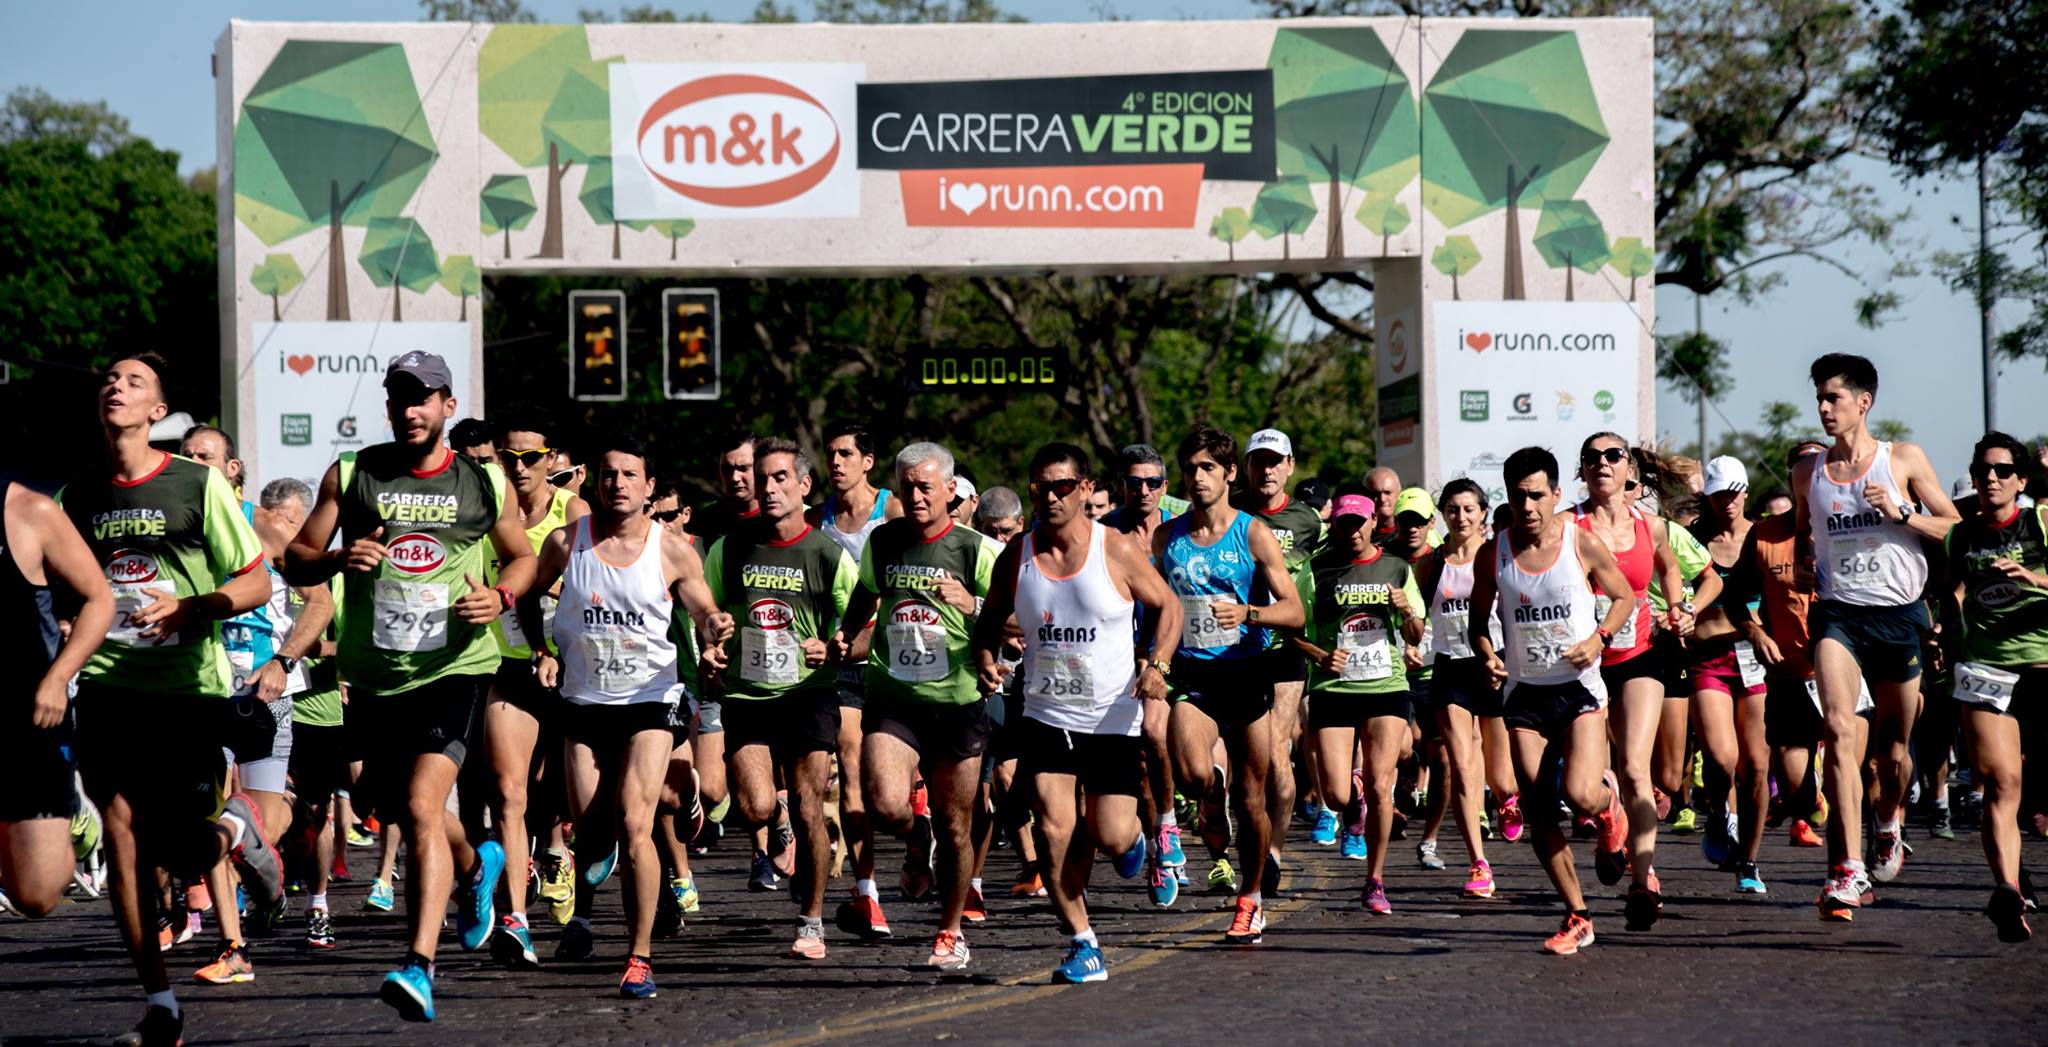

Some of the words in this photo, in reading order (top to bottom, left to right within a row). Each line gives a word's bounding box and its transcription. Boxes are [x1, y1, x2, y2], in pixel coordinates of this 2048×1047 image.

[1152, 91, 1253, 115] EDICION
[663, 112, 804, 167] m&k
[377, 492, 458, 507] CARRERA
[93, 508, 166, 525] CARRERA
[377, 503, 458, 523] VERDE
[1826, 511, 1882, 531] ATENAS
[93, 518, 167, 541] VERDE
[393, 545, 434, 562] m&k
[110, 559, 149, 576] m&k
[742, 564, 804, 579] CARRERA
[885, 564, 945, 579] CARRERA
[1839, 555, 1880, 576] 566
[742, 572, 805, 593] VERDE
[1334, 583, 1390, 593] CARRERA
[1334, 591, 1390, 606] VERDE
[385, 609, 435, 633] 296
[583, 606, 645, 626] ATENAS
[753, 608, 787, 621] m&k
[895, 609, 931, 624] m&k
[1514, 602, 1572, 623] ATENAS
[1038, 624, 1097, 643] ATENAS
[1190, 617, 1219, 635] 58
[1347, 620, 1377, 633] m&k
[593, 656, 637, 676] 245
[750, 650, 789, 670] 359
[898, 648, 937, 667] 625
[1347, 649, 1384, 668] 444
[1040, 676, 1083, 696] 258
[1960, 674, 2002, 696] 679
